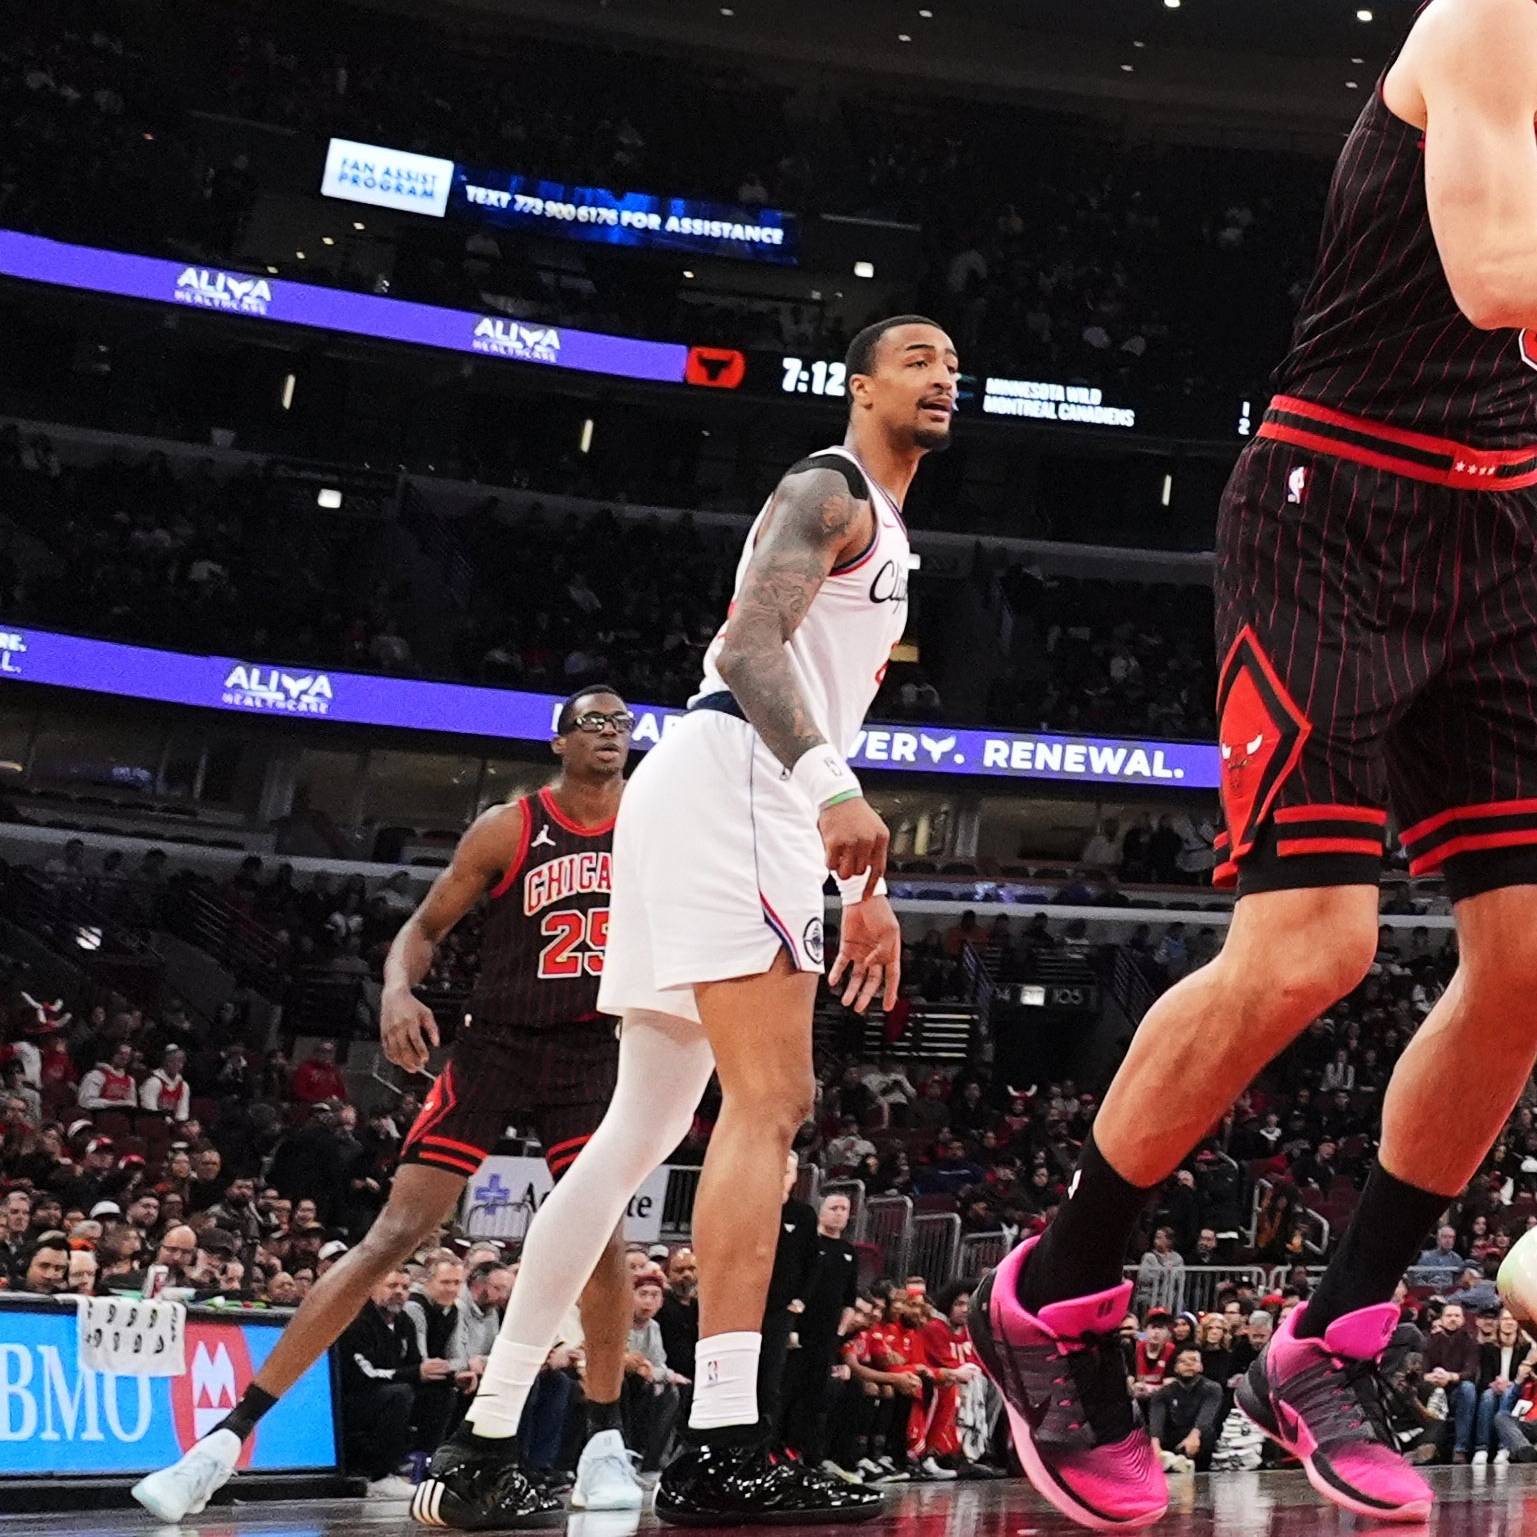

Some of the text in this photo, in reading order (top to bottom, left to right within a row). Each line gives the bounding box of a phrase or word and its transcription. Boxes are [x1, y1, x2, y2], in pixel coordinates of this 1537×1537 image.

[338, 172, 437, 201] PROGRAM
[339, 157, 438, 185] FAN ASSIST
[466, 185, 512, 210] TEXT
[621, 211, 662, 231] FOR
[664, 214, 785, 246] ASSISTANCE
[781, 357, 847, 398] 7:12
[985, 377, 1103, 406] MINNESOTA WILD
[983, 395, 1136, 428] MONTREAL CANADIENS
[1239, 418, 1250, 435] 2
[983, 740, 1185, 779] RENEWAL.
[524, 852, 613, 917] CHICA
[537, 908, 610, 979] 25
